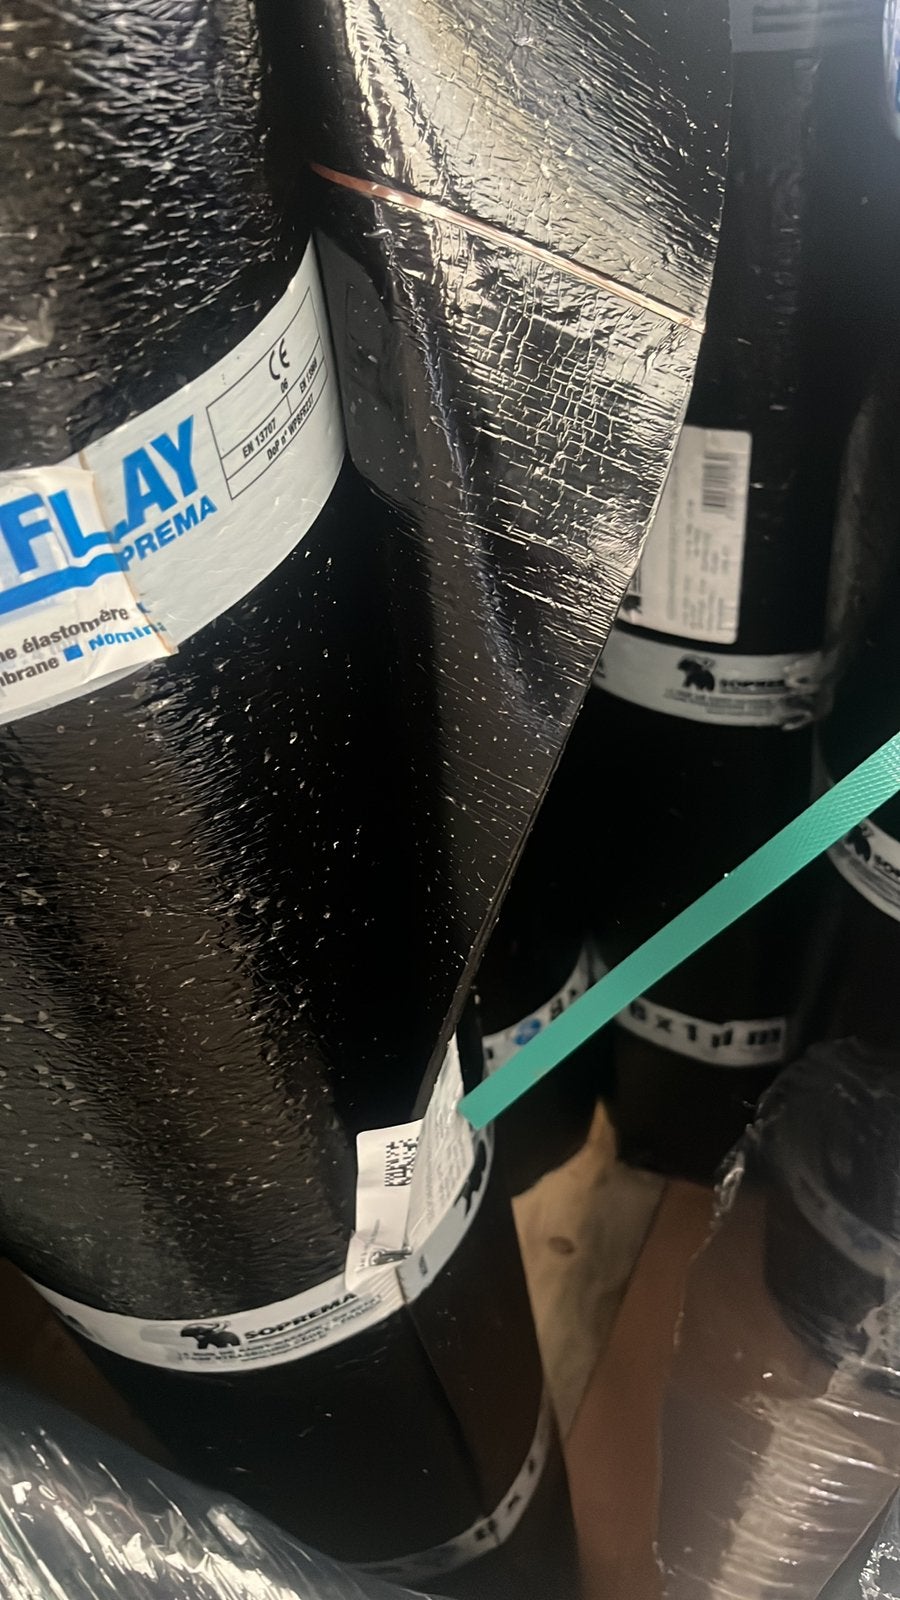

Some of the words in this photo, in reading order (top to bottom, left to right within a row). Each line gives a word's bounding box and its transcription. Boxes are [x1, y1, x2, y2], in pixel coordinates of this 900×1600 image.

[299, 377, 307, 393] EN
[242, 443, 254, 458] EN
[255, 417, 277, 446] 13707
[266, 439, 281, 460] DoP
[22, 608, 129, 654] élastomère
[244, 1293, 357, 1340] SOPREMA
